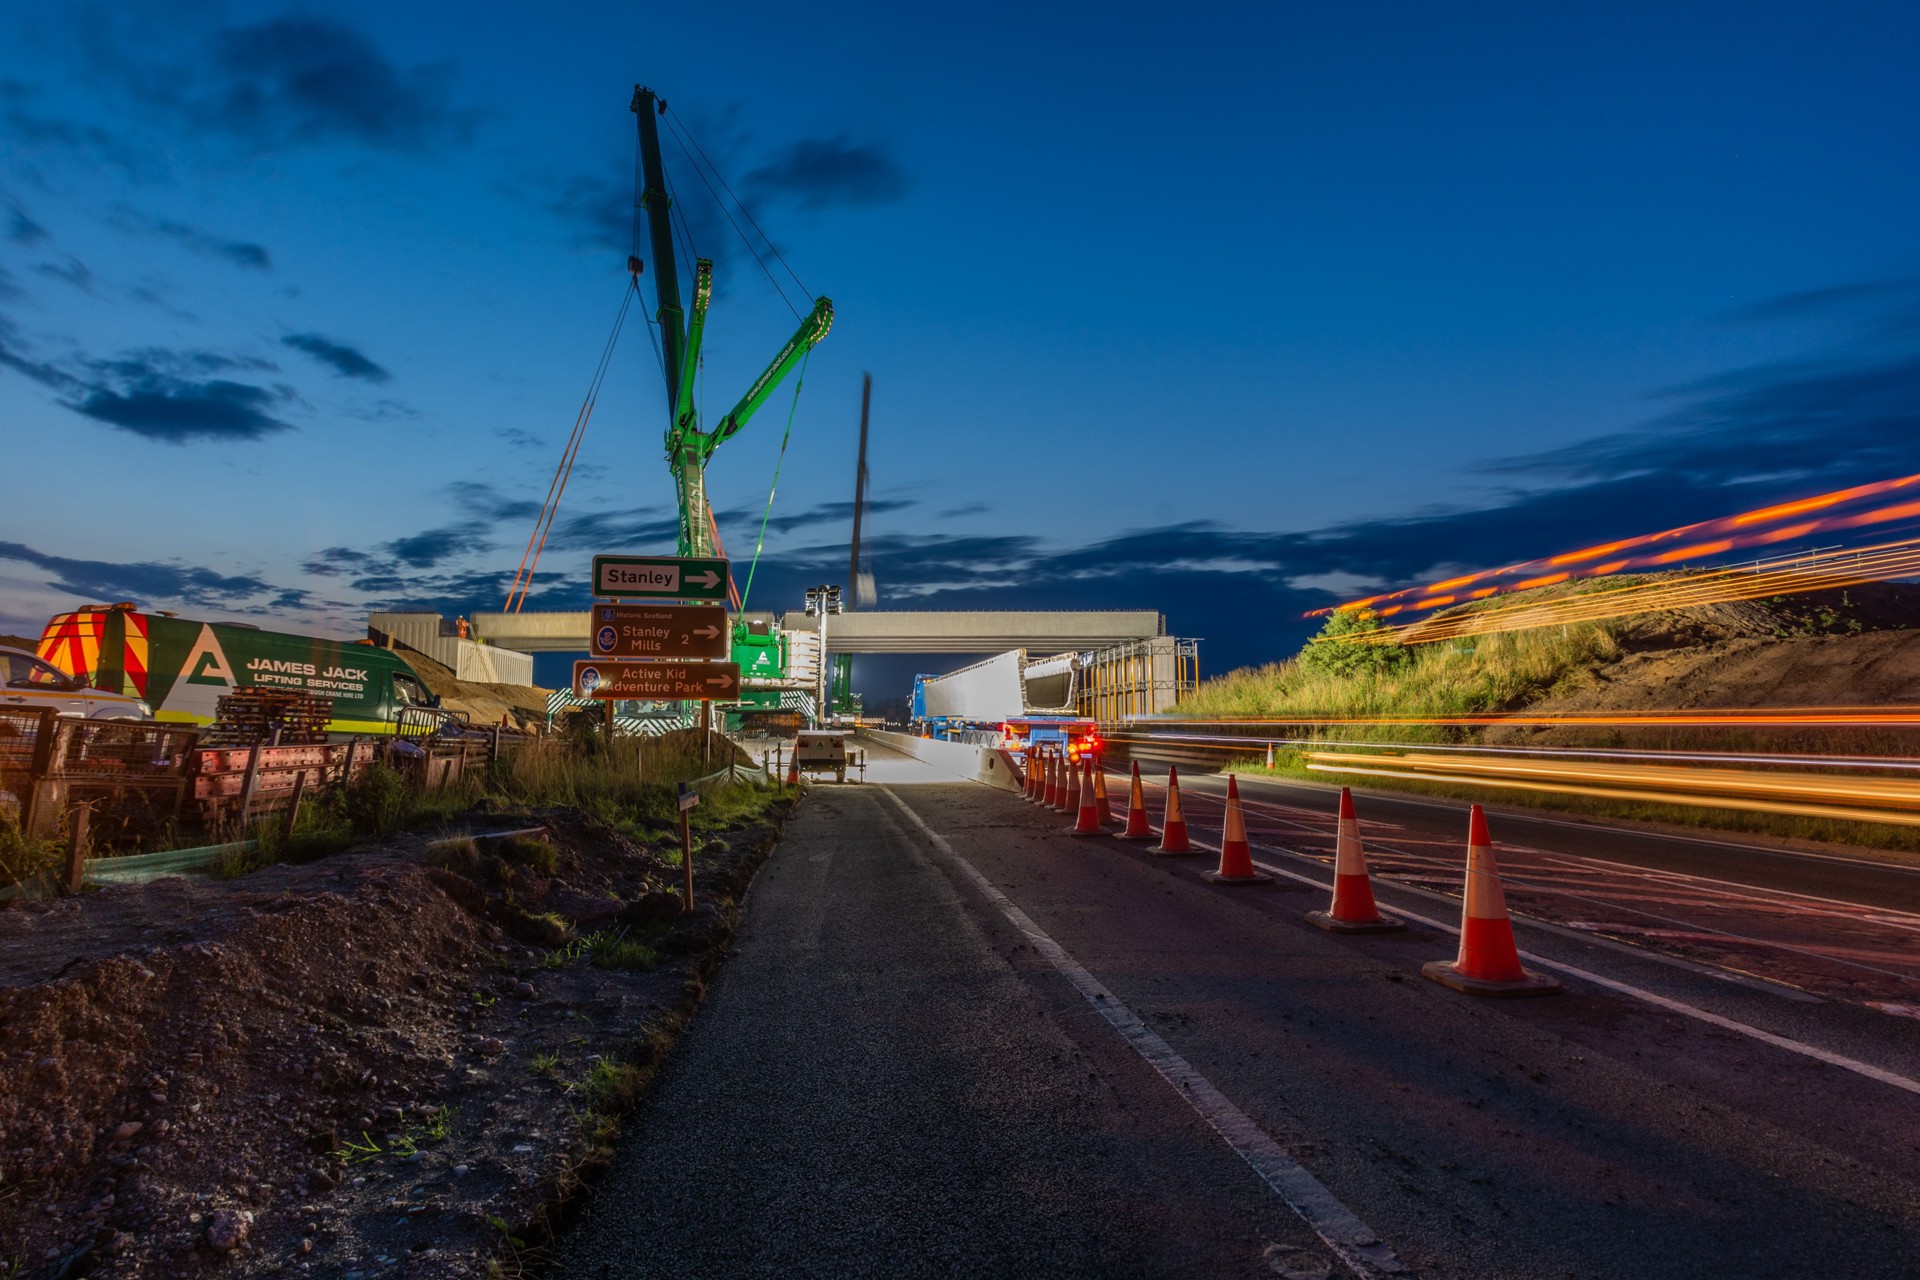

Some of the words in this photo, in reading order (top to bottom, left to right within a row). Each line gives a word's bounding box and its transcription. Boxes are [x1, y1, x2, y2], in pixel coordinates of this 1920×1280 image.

[676, 464, 684, 506] JAMES
[680, 512, 689, 545] JACK
[608, 569, 673, 587] Stanley
[622, 626, 670, 640] Stanley
[631, 640, 661, 650] Mills
[681, 634, 689, 644] 2
[246, 658, 316, 676] JAMES
[322, 666, 368, 681] JACK
[622, 668, 662, 679] Active
[666, 668, 686, 679] Kid
[254, 674, 302, 685] LIFTING
[306, 678, 364, 691] SERVICES
[606, 681, 670, 692] Adventure
[675, 682, 704, 693] Park
